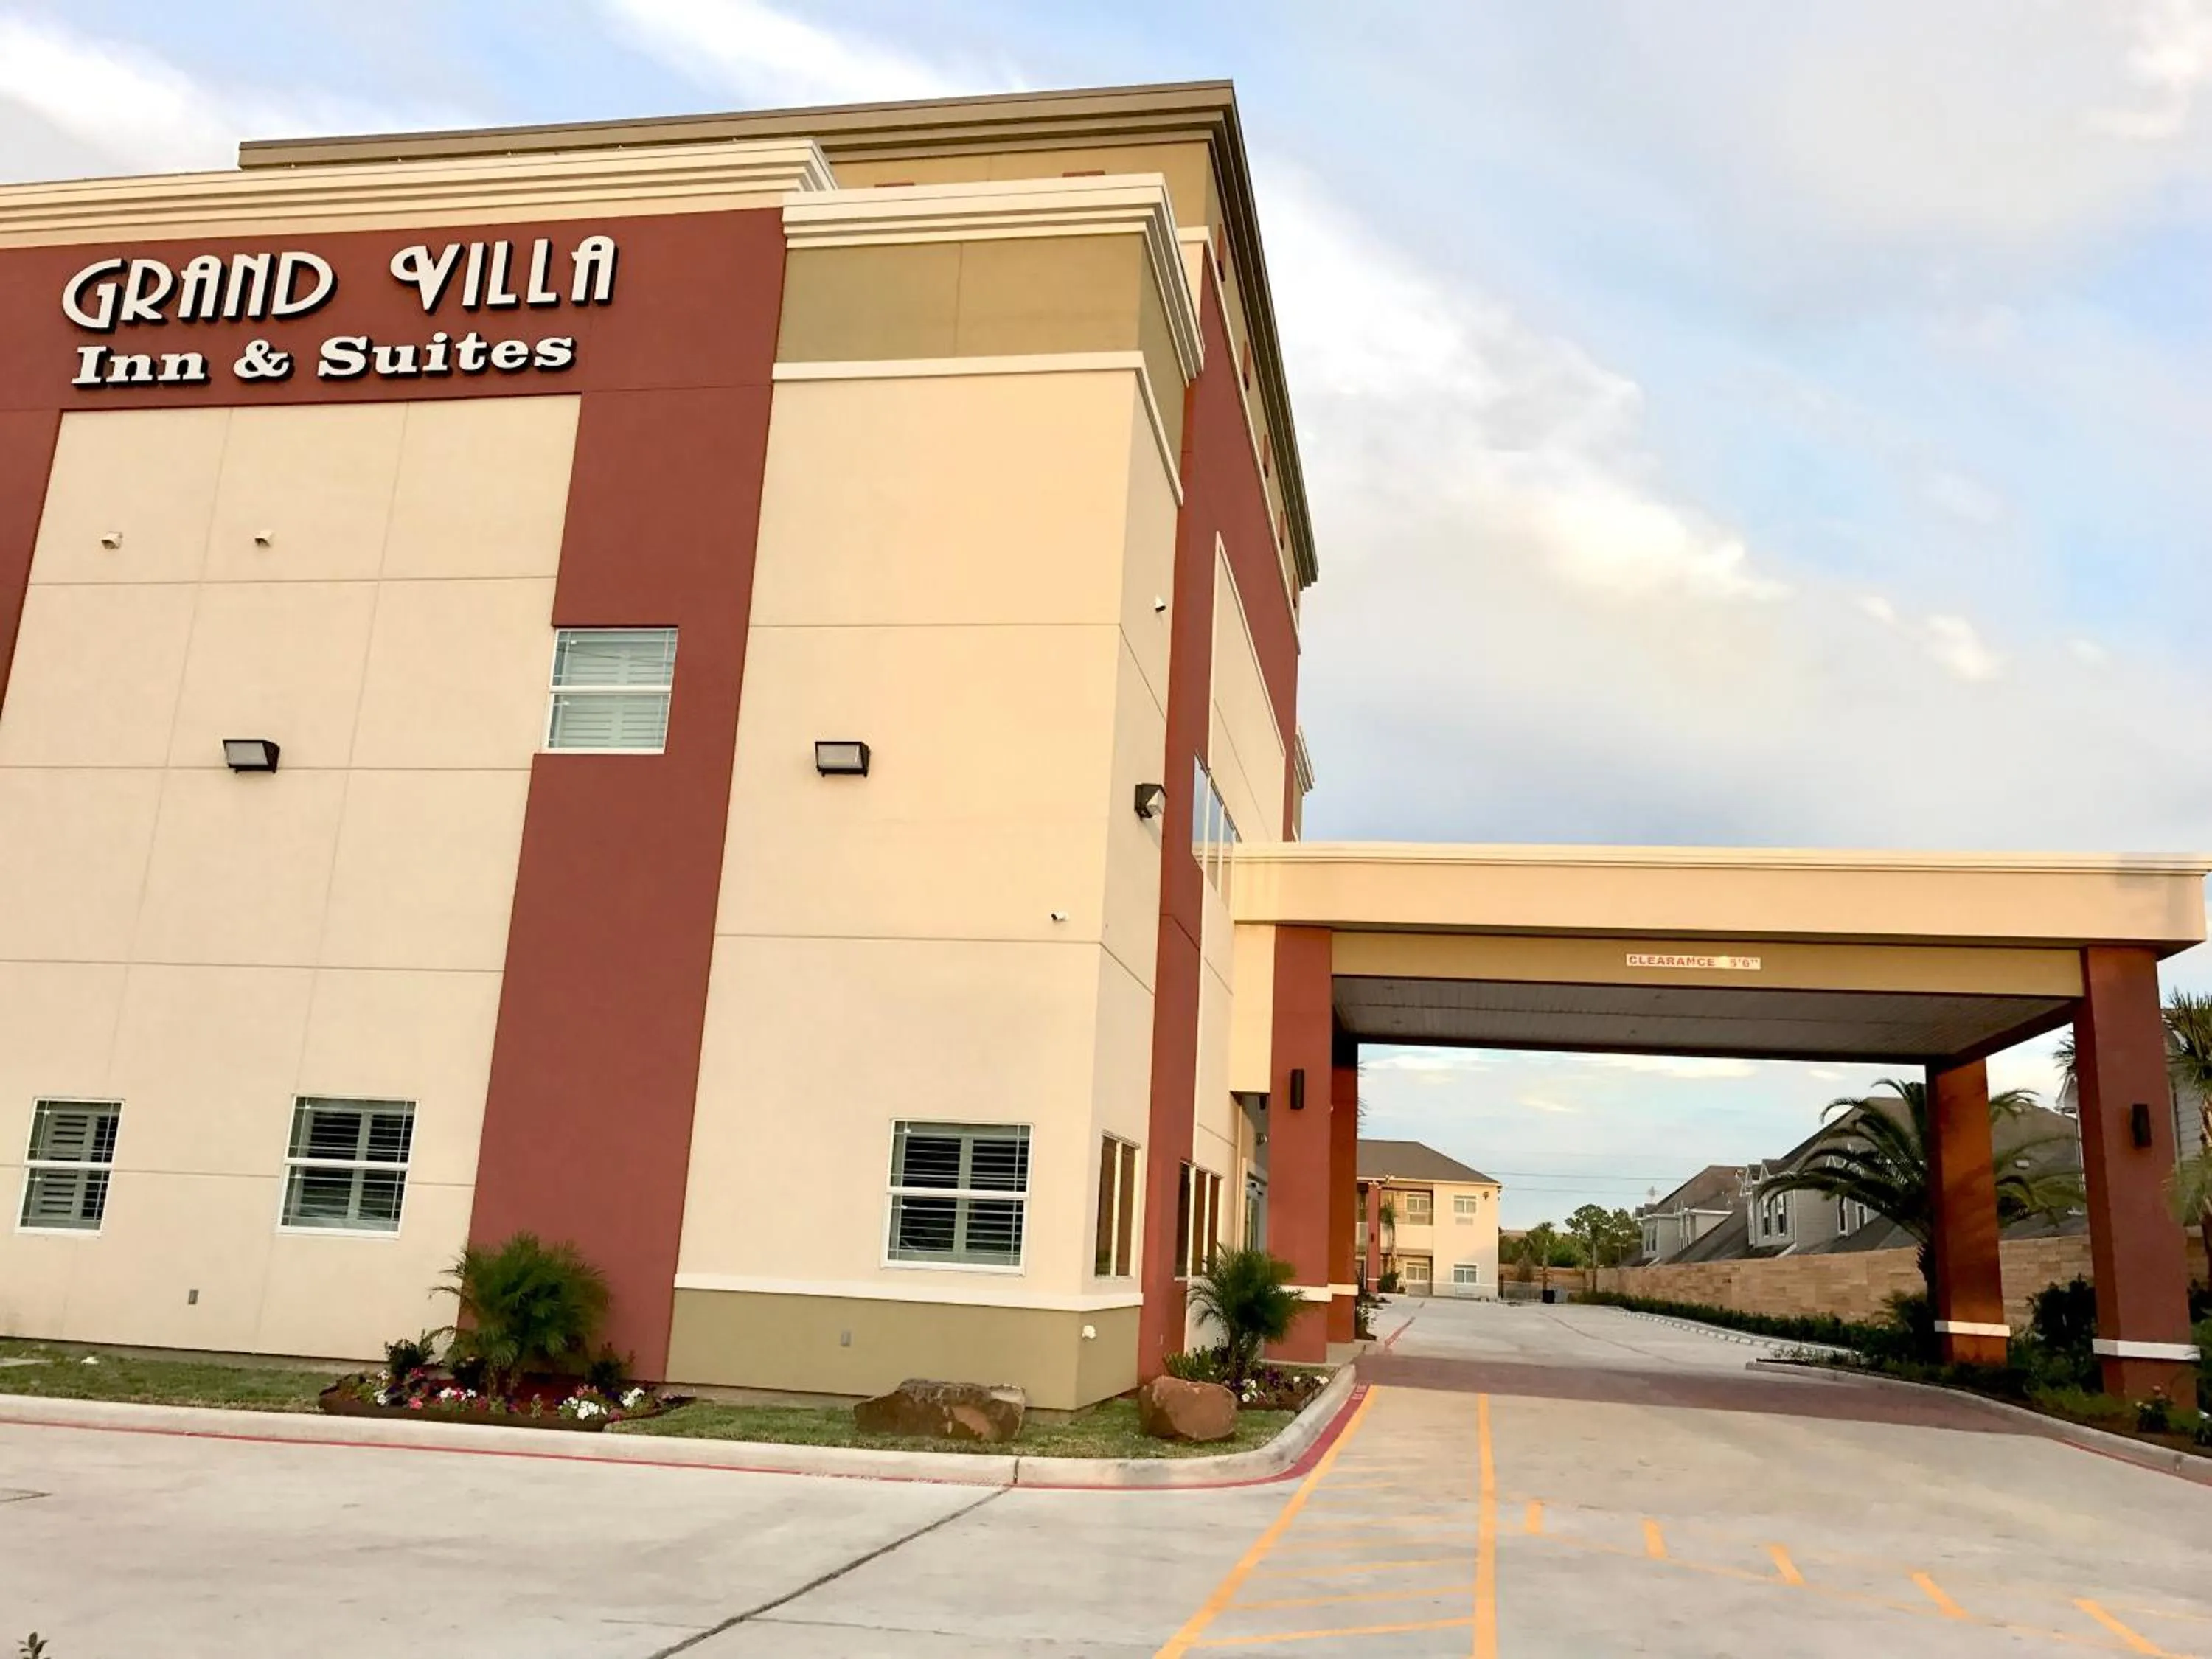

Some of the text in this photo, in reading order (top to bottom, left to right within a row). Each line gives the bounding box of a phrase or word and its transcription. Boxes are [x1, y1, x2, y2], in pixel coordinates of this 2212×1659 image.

[62, 235, 617, 329] GRAND VILLA
[72, 332, 572, 384] Inn & Suites
[1629, 954, 1715, 967] CLEARANCE
